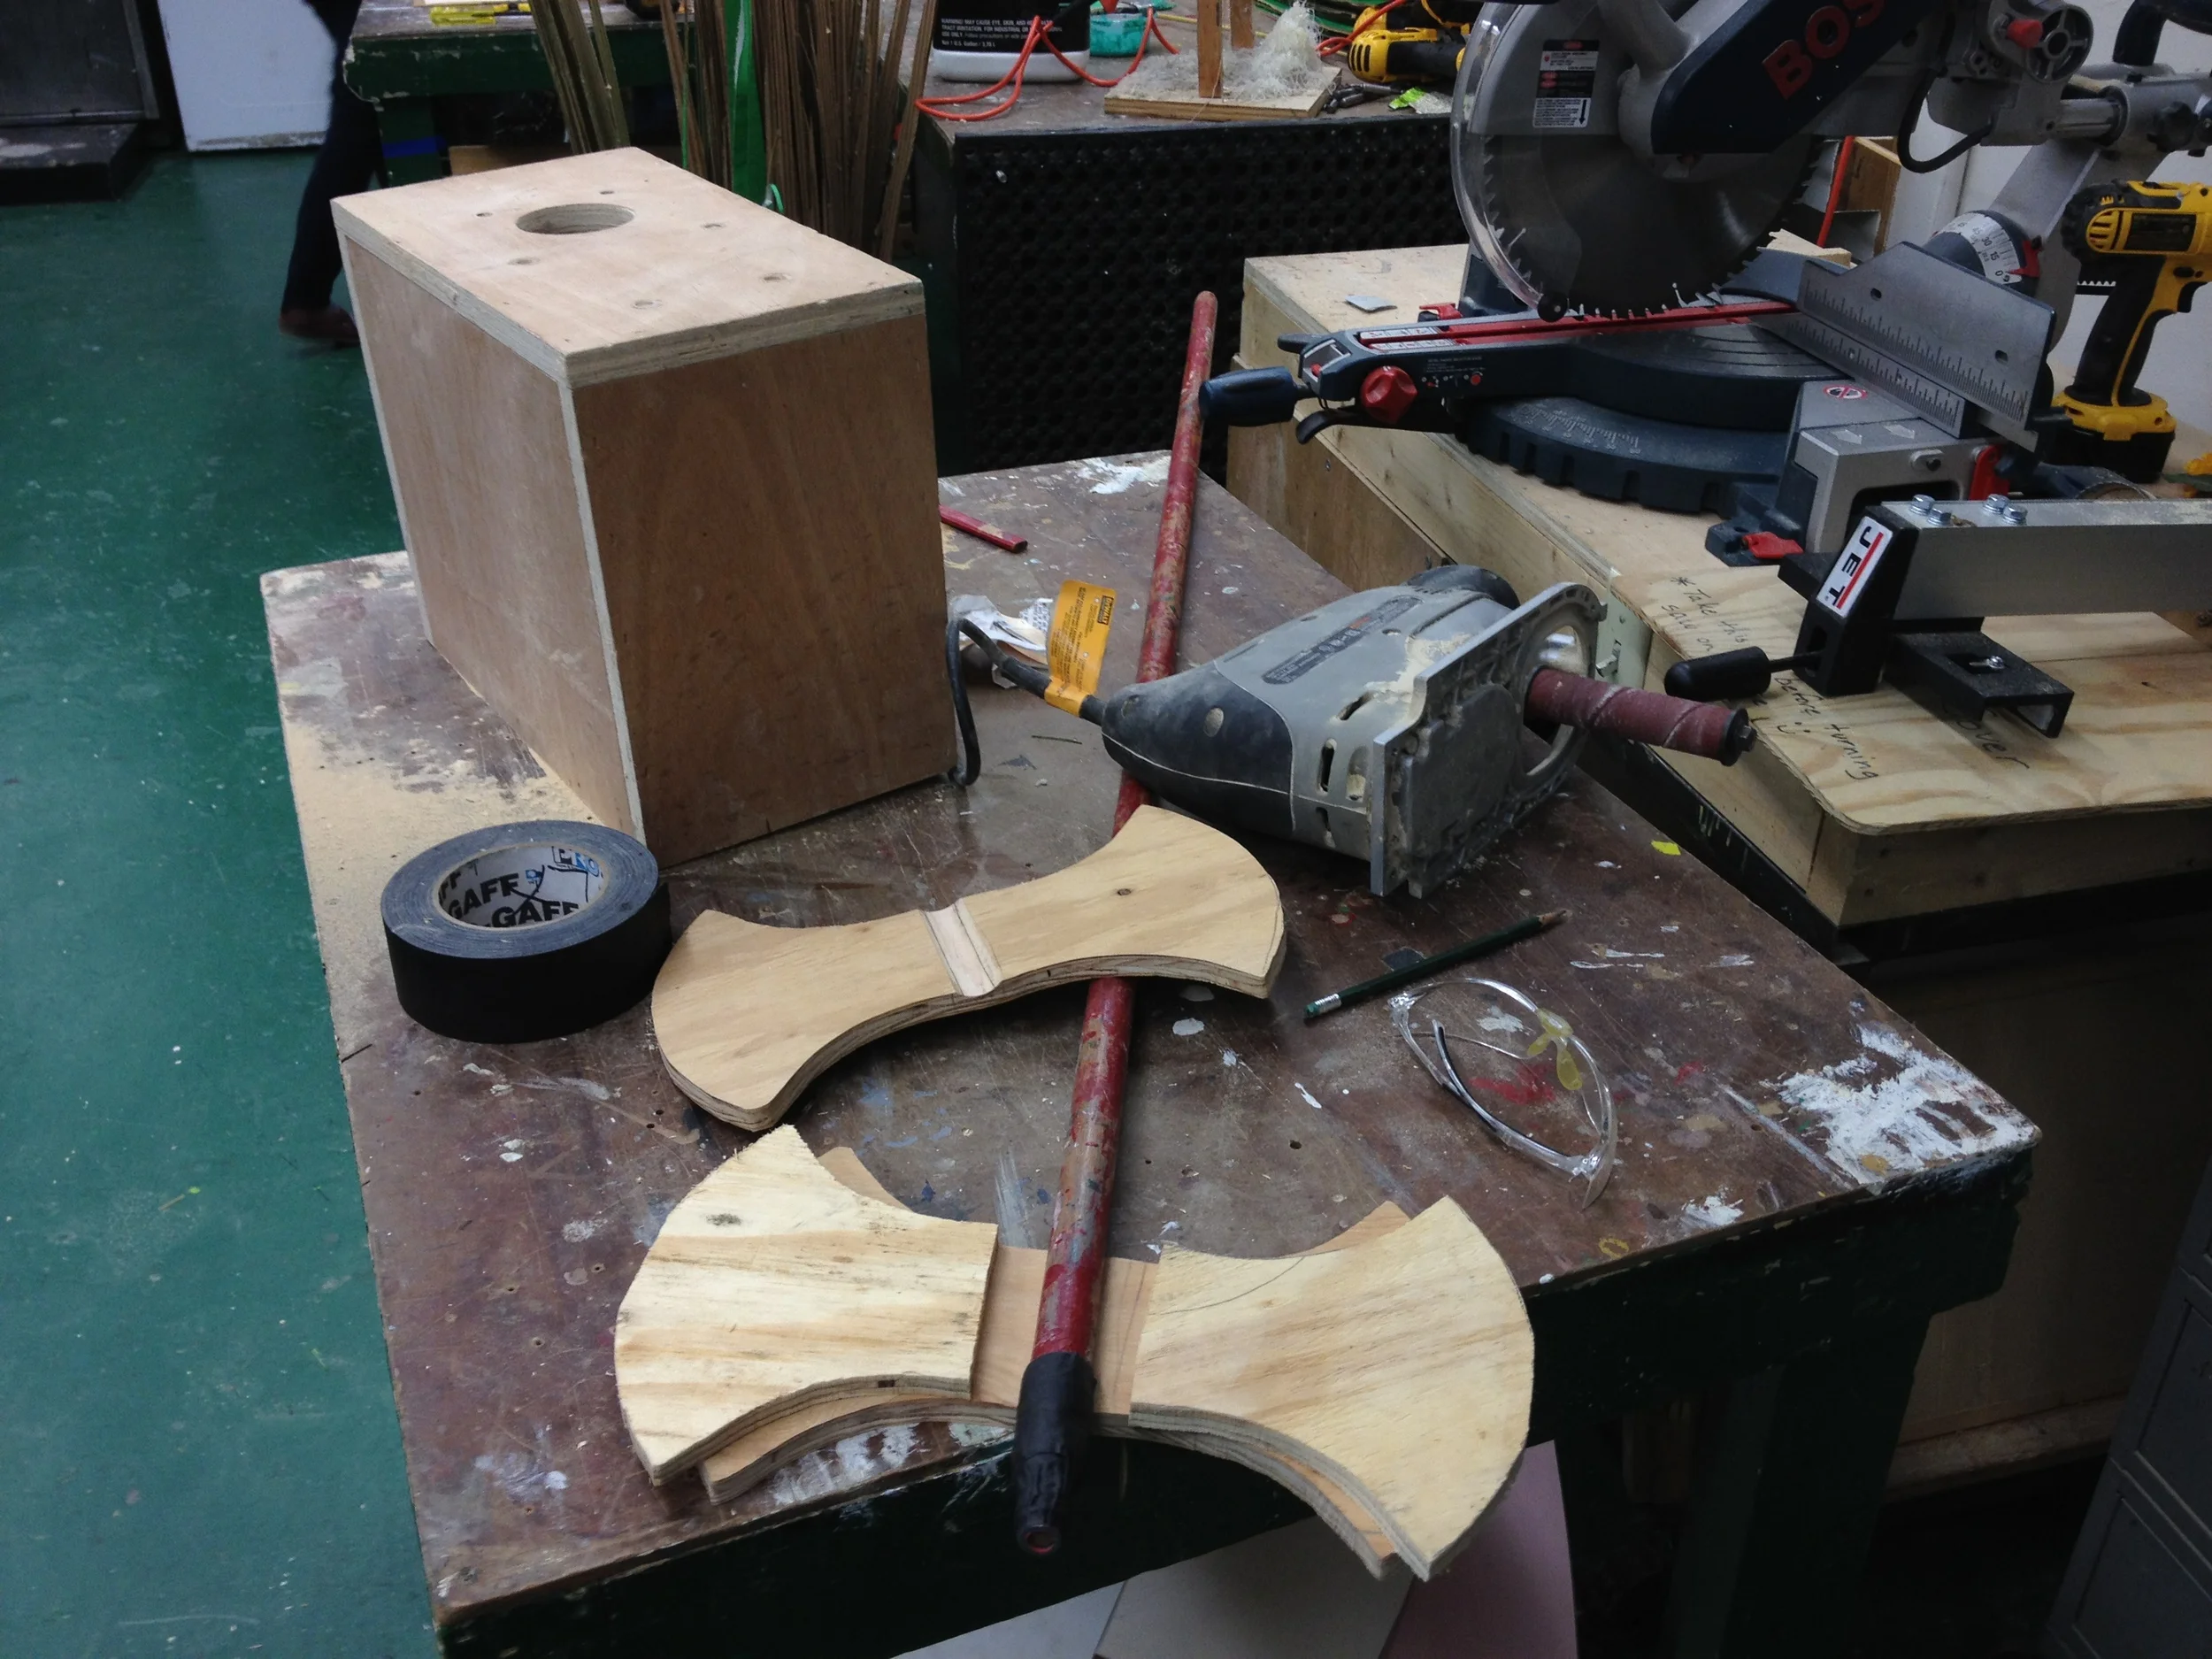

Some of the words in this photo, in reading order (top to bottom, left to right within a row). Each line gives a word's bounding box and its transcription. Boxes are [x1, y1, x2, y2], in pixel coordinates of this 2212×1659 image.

[1982, 236, 1992, 246] 30
[1990, 251, 2000, 261] 15
[1829, 526, 1871, 605] JET
[1684, 589, 1719, 615] Take
[1774, 678, 1824, 716] before
[1824, 724, 1878, 780] turning
